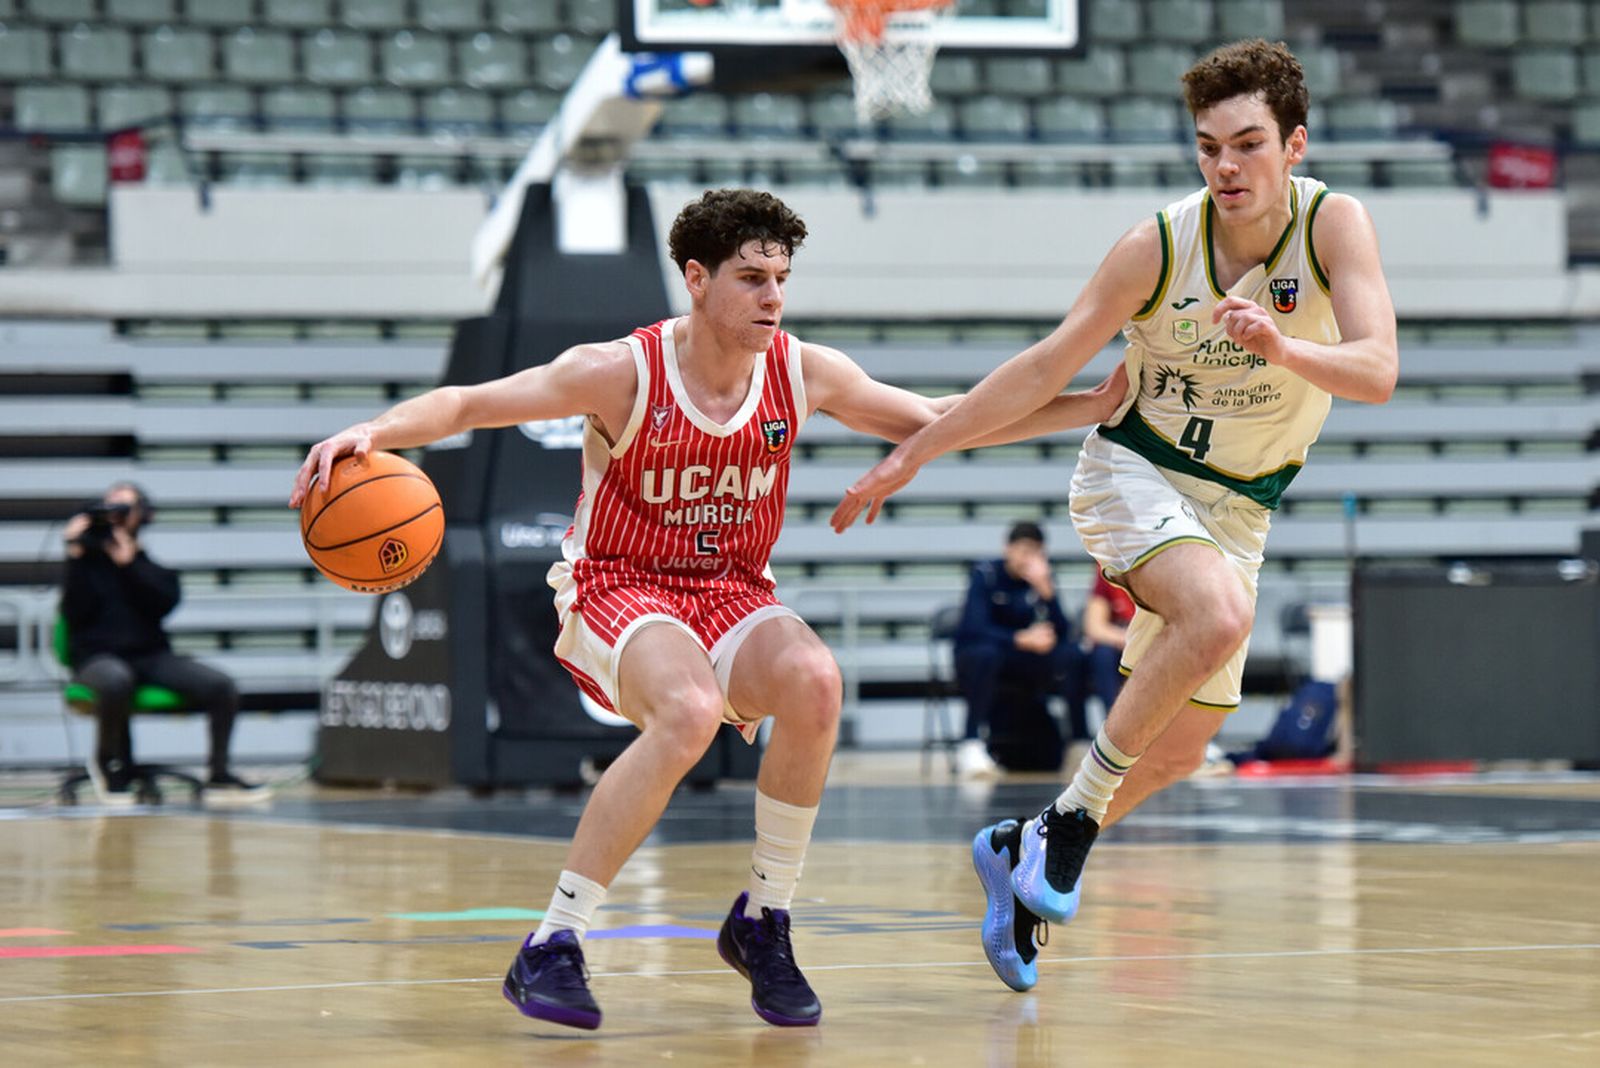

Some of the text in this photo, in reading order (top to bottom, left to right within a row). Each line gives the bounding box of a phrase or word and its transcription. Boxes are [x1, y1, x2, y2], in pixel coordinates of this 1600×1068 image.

[1271, 280, 1297, 290] LIGA
[1211, 391, 1282, 407] de la Torre
[763, 420, 787, 432] LIGA
[1178, 416, 1214, 461] 4
[642, 463, 778, 504] UCAM
[663, 504, 753, 527] MURCIA
[696, 530, 720, 555] 5
[661, 555, 724, 571] Juver
